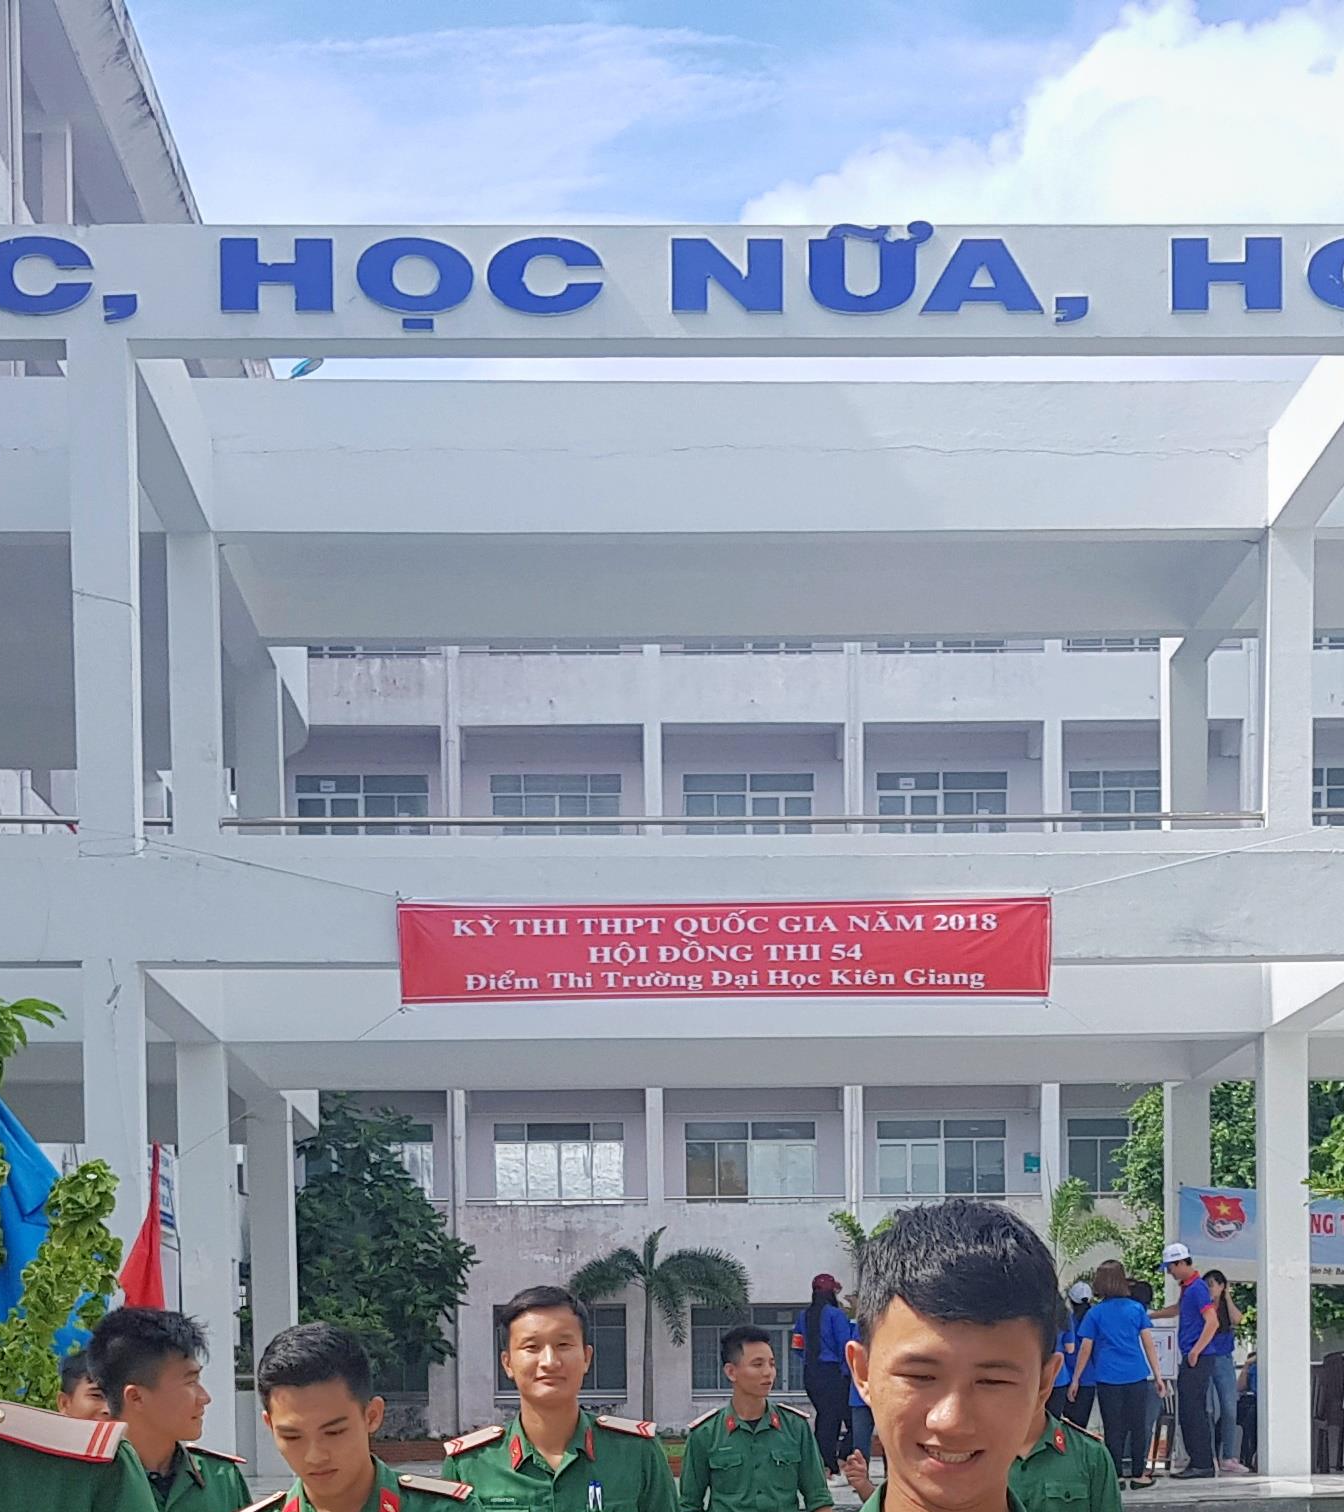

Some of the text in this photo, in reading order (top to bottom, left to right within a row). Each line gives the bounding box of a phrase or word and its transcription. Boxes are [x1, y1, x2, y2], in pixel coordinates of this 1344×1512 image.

[220, 236, 604, 332] HỌC
[671, 220, 1089, 325] NỮA,
[452, 910, 998, 937] KỲ THI THPT QUỐC GIA NĂM 2018
[588, 938, 863, 966] HỘI ĐỒNG THI 54
[465, 969, 986, 991] Điểm Thi Trường Đại Học Kiên Giang
